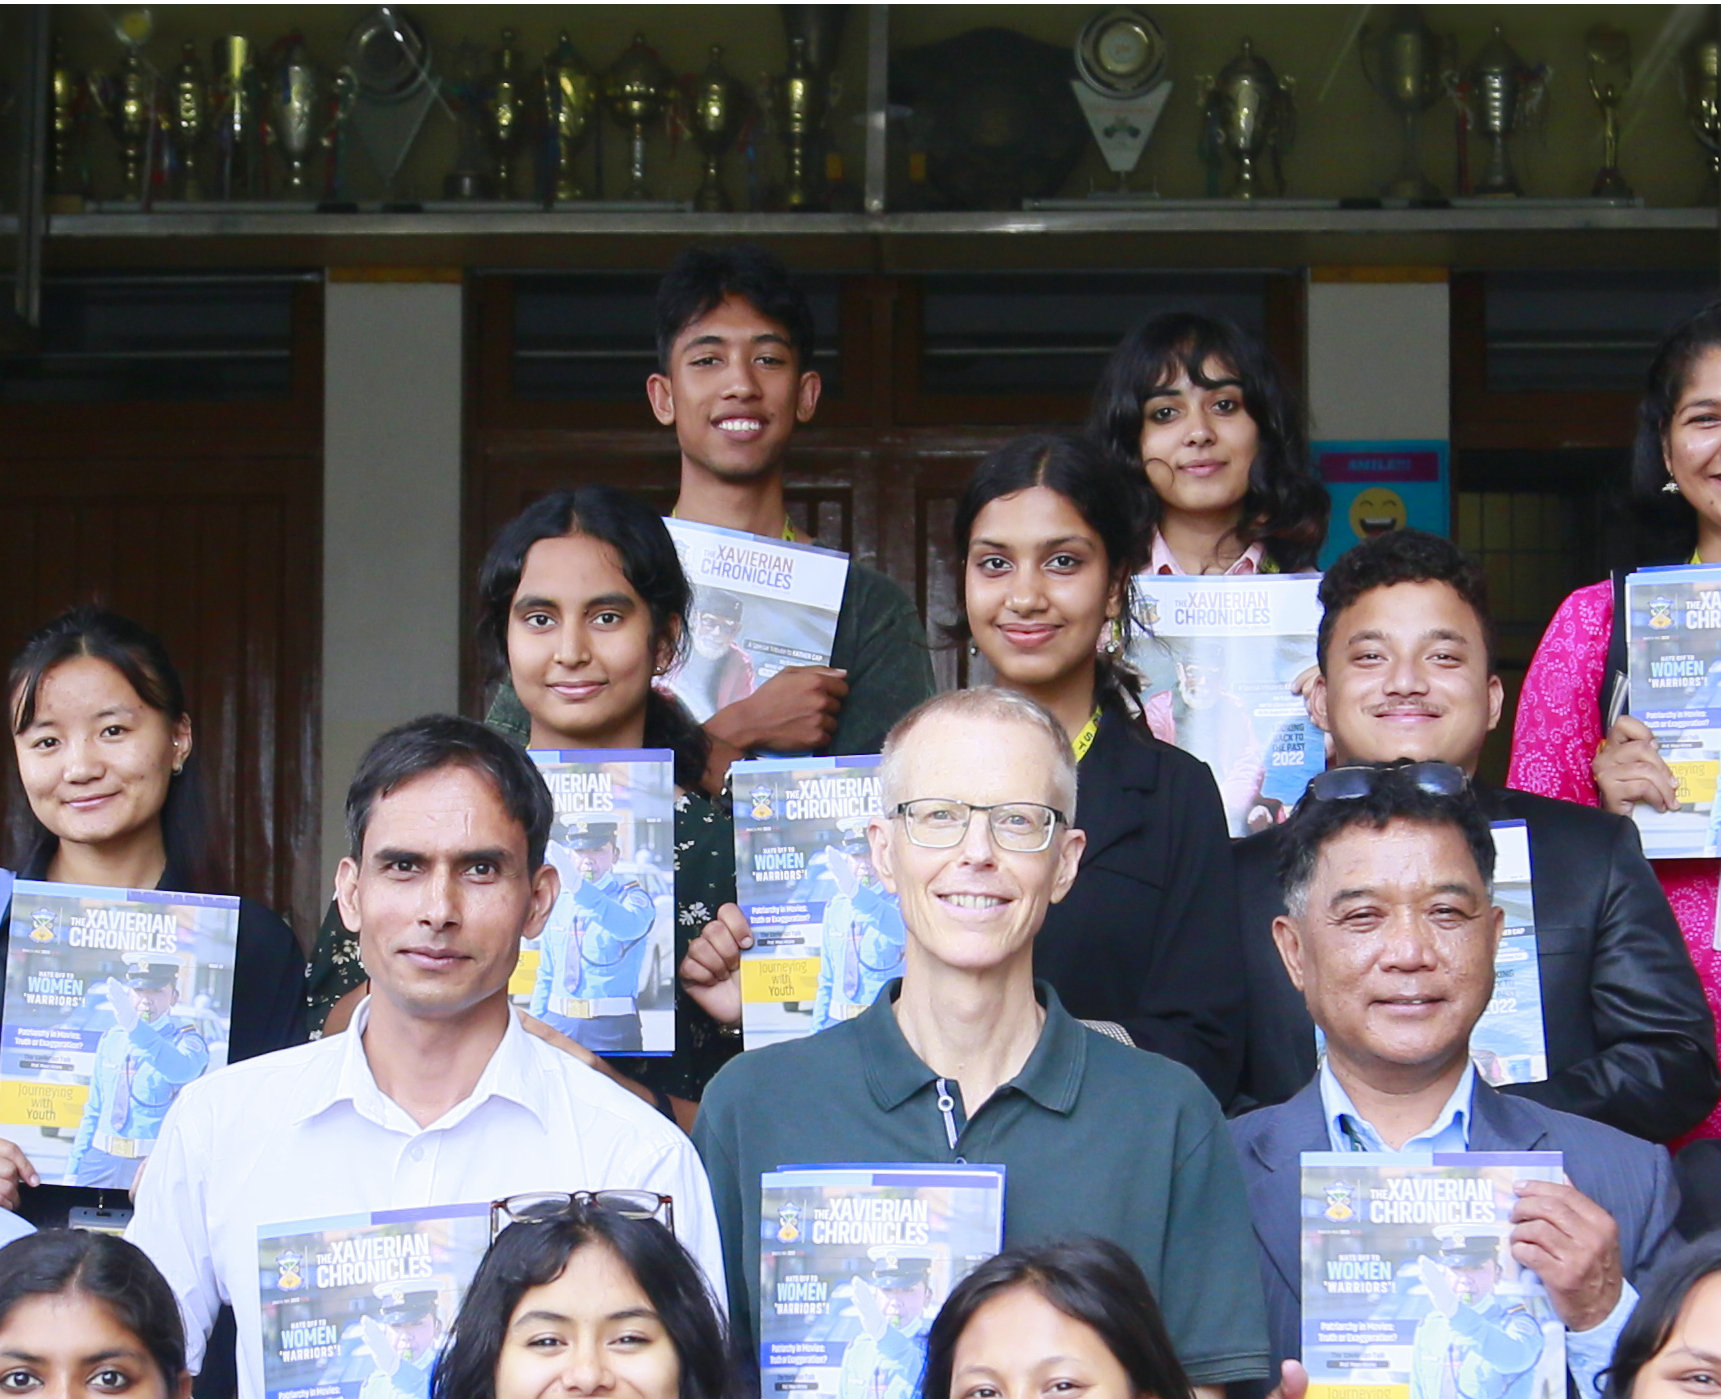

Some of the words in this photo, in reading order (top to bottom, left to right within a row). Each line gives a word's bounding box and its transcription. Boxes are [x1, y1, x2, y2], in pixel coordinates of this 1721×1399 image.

[703, 549, 715, 559] THE
[716, 545, 794, 573] XAVIERIAN
[701, 558, 792, 590] CHRONICLES
[1175, 599, 1187, 608] THE
[1187, 591, 1269, 609] XAVIERIAN
[1686, 601, 1700, 610] THE
[1175, 608, 1270, 625] CHRONICLES
[1651, 660, 1704, 677] WOMEN
[1286, 742, 1305, 751] PAST
[1272, 751, 1304, 766] 2022
[785, 790, 800, 800] THE
[799, 777, 883, 798] XAVIERIAN
[754, 852, 804, 870] WOMEN
[70, 916, 86, 927] THE
[86, 909, 177, 934] XAVIERIAN
[69, 927, 178, 952] CHRONICLES
[758, 961, 807, 976] Journeying
[28, 976, 83, 996] WOMEN
[771, 974, 791, 986] with
[23, 993, 86, 1007] 'WARRIORS'!
[767, 984, 795, 997] Youth
[17, 1084, 73, 1100] Journeying
[31, 1098, 53, 1110] with
[26, 1108, 56, 1121] Youth
[1370, 1188, 1388, 1200] THE
[1387, 1178, 1493, 1201] XAVIERIAN
[814, 1209, 829, 1220] THE
[829, 1198, 927, 1222] XAVIERIAN
[1369, 1201, 1496, 1224] CHRONICLES
[812, 1220, 929, 1245] CHRONICLES
[316, 1253, 332, 1265] THE
[330, 1233, 428, 1264] XAVIERIAN
[316, 1255, 432, 1289] CHRONICLES
[1327, 1261, 1391, 1281] WOMEN
[777, 1282, 827, 1301] WOMEN
[281, 1325, 337, 1349] WOMEN
